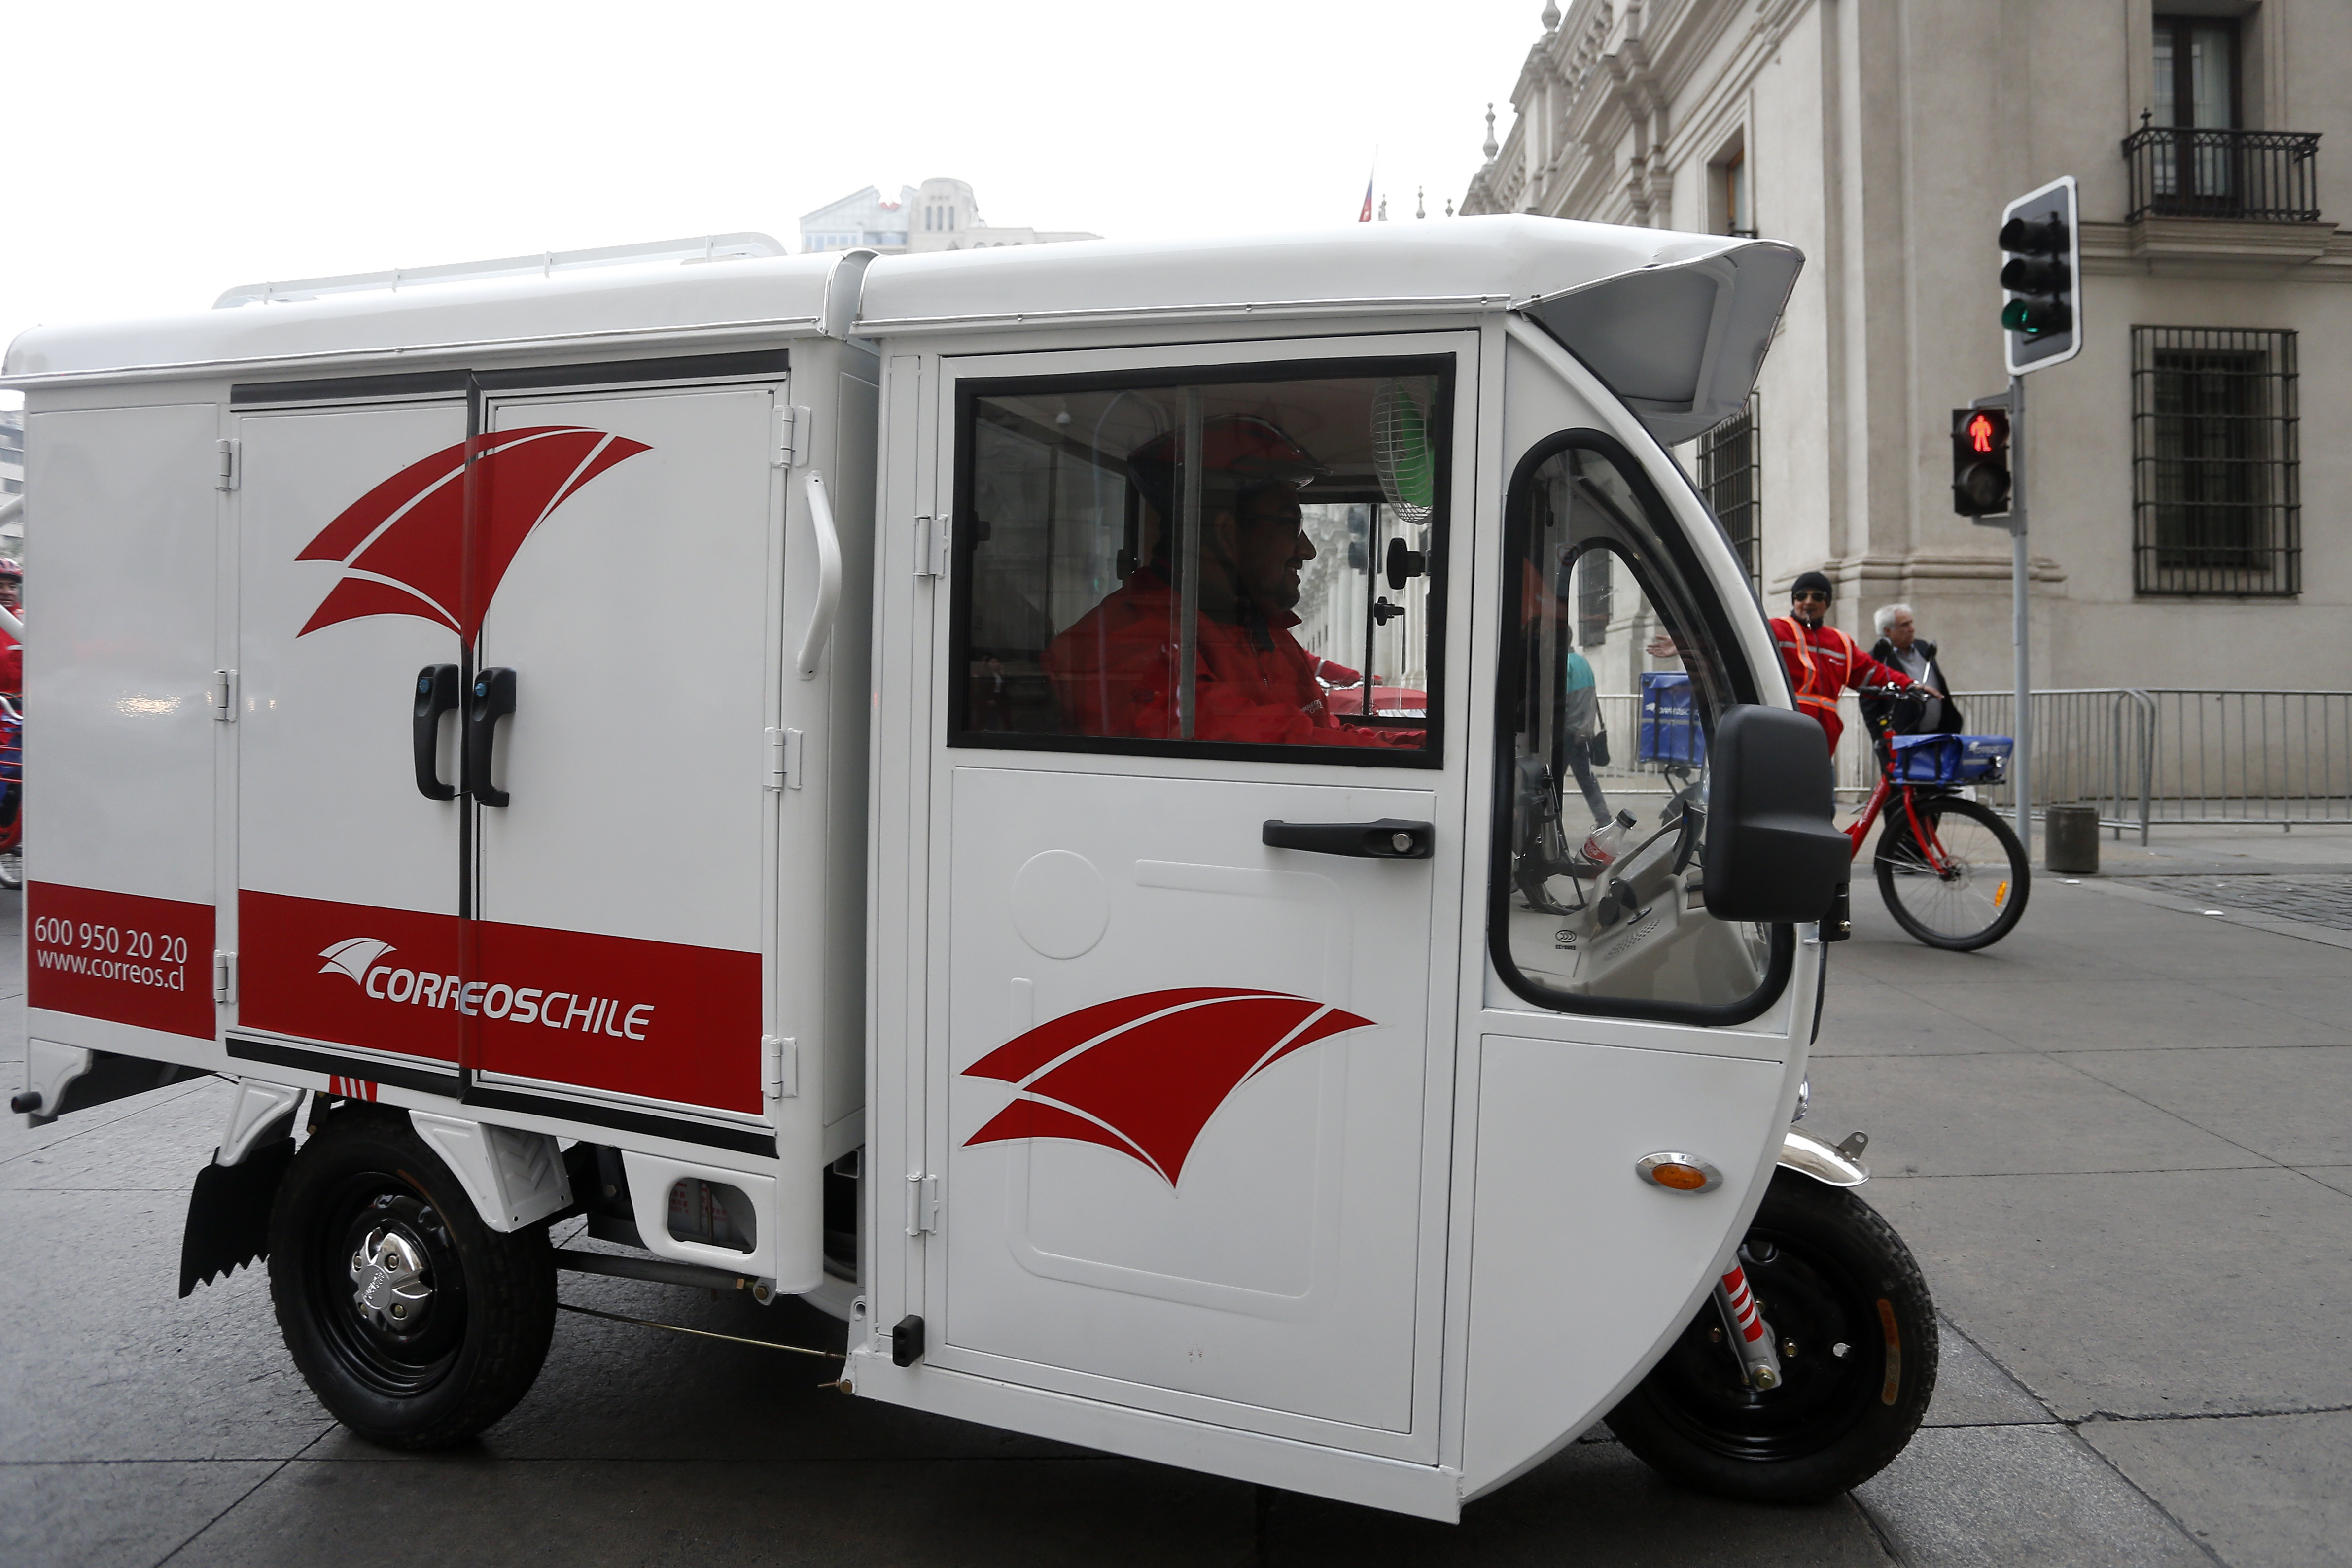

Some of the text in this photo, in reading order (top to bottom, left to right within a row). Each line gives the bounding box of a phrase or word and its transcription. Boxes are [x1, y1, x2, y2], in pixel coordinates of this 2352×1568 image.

[35, 916, 187, 964] 600 950 20 20
[37, 949, 184, 991] www.correos.cl
